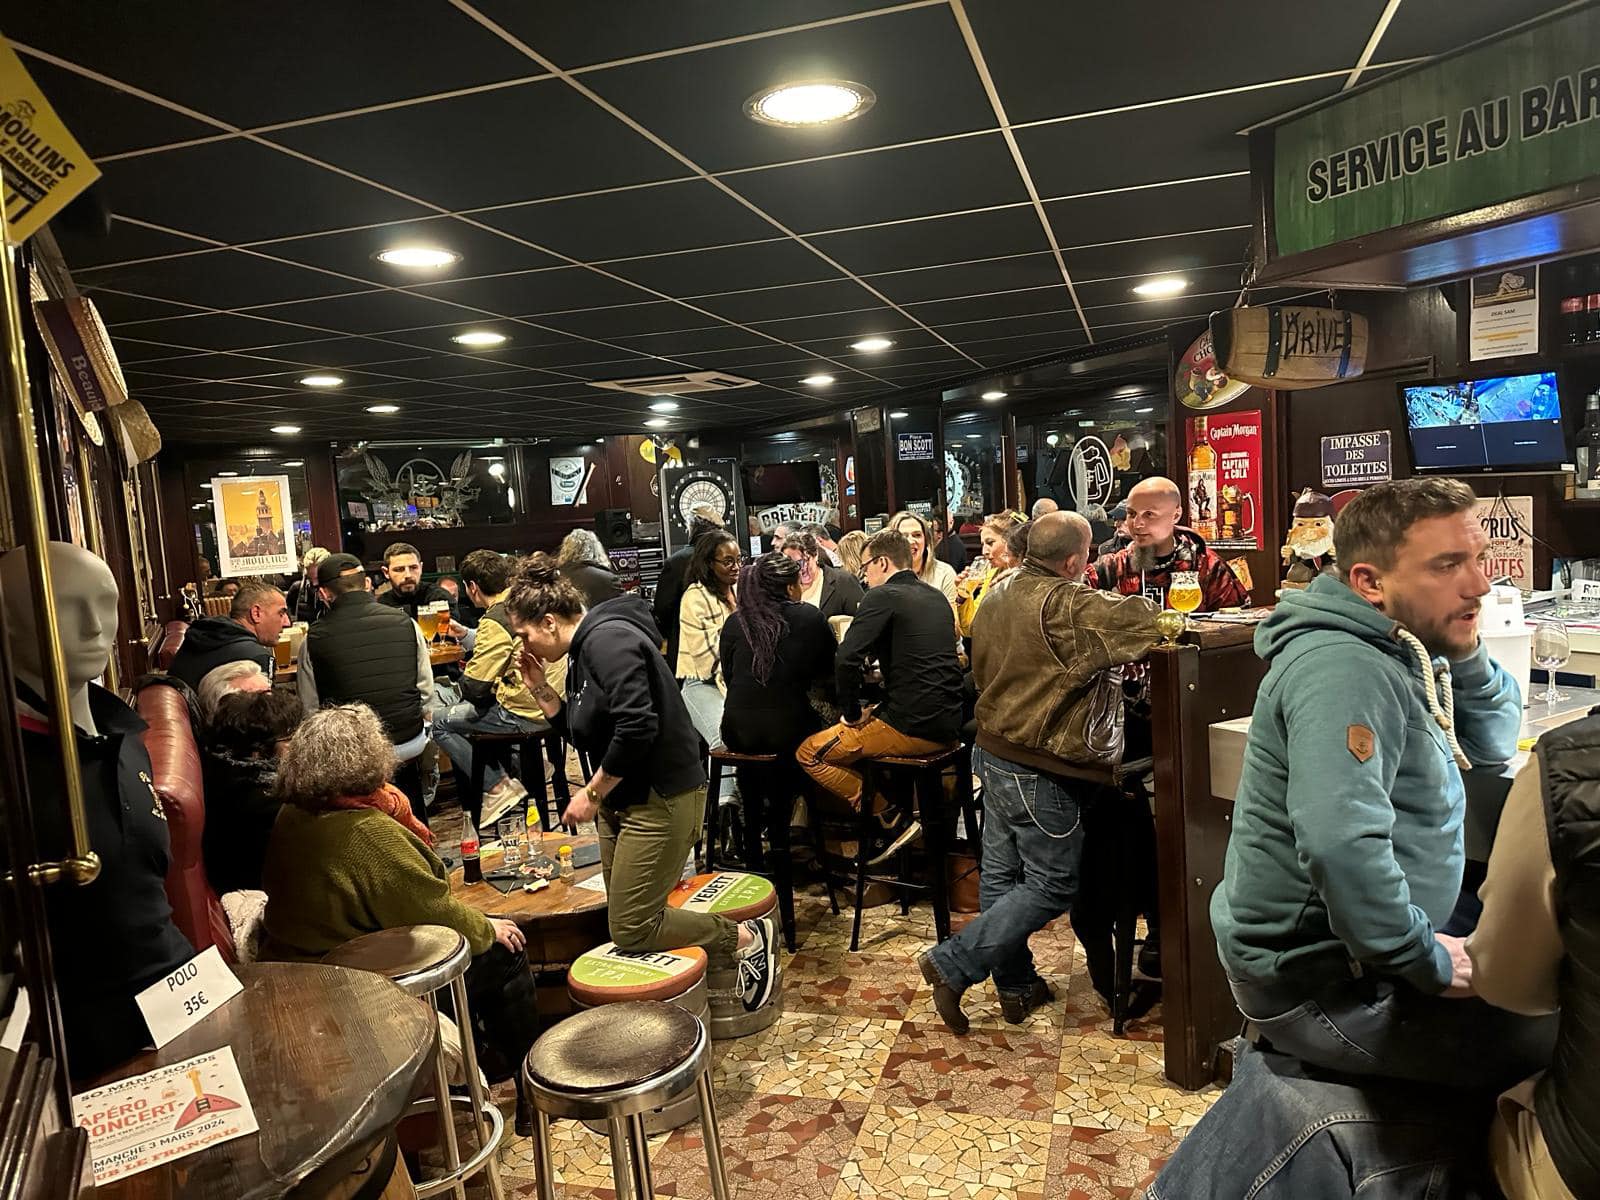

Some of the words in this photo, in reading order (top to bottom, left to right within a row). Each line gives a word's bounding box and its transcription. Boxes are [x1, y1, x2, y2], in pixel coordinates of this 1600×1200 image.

[1307, 116, 1449, 203] SERVICE
[1455, 96, 1512, 160] AU
[1520, 66, 1600, 141] BAR
[1283, 310, 1344, 360] DRIVE
[1210, 425, 1232, 440] Captain
[1231, 424, 1257, 438] Morgan
[1330, 434, 1380, 450] IMPASSE
[899, 439, 912, 451] BON
[913, 439, 932, 451] SCOTT
[1345, 449, 1365, 460] DES
[1221, 459, 1249, 470] CAPTAIN
[1230, 469, 1248, 479] COLA
[1324, 460, 1387, 477] TOILETTES
[761, 507, 826, 528] BREWERY
[1484, 558, 1524, 578] UITES
[690, 876, 735, 903] VEDETT
[738, 885, 763, 900] IPA
[607, 946, 682, 966] VETT
[165, 962, 198, 992] POLO
[587, 968, 626, 982] IPA
[183, 991, 209, 1016] 35€
[81, 1090, 102, 1102] SO
[107, 1074, 158, 1092] MANY
[162, 1055, 216, 1073] ROADS
[79, 1099, 147, 1127] APÉRO
[86, 1100, 177, 1137] ONCERT
[93, 1146, 146, 1168] MANCHE
[148, 1140, 157, 1149] 3
[159, 1129, 194, 1146] MARS
[197, 1118, 225, 1134] 2024
[124, 1159, 148, 1171] LE
